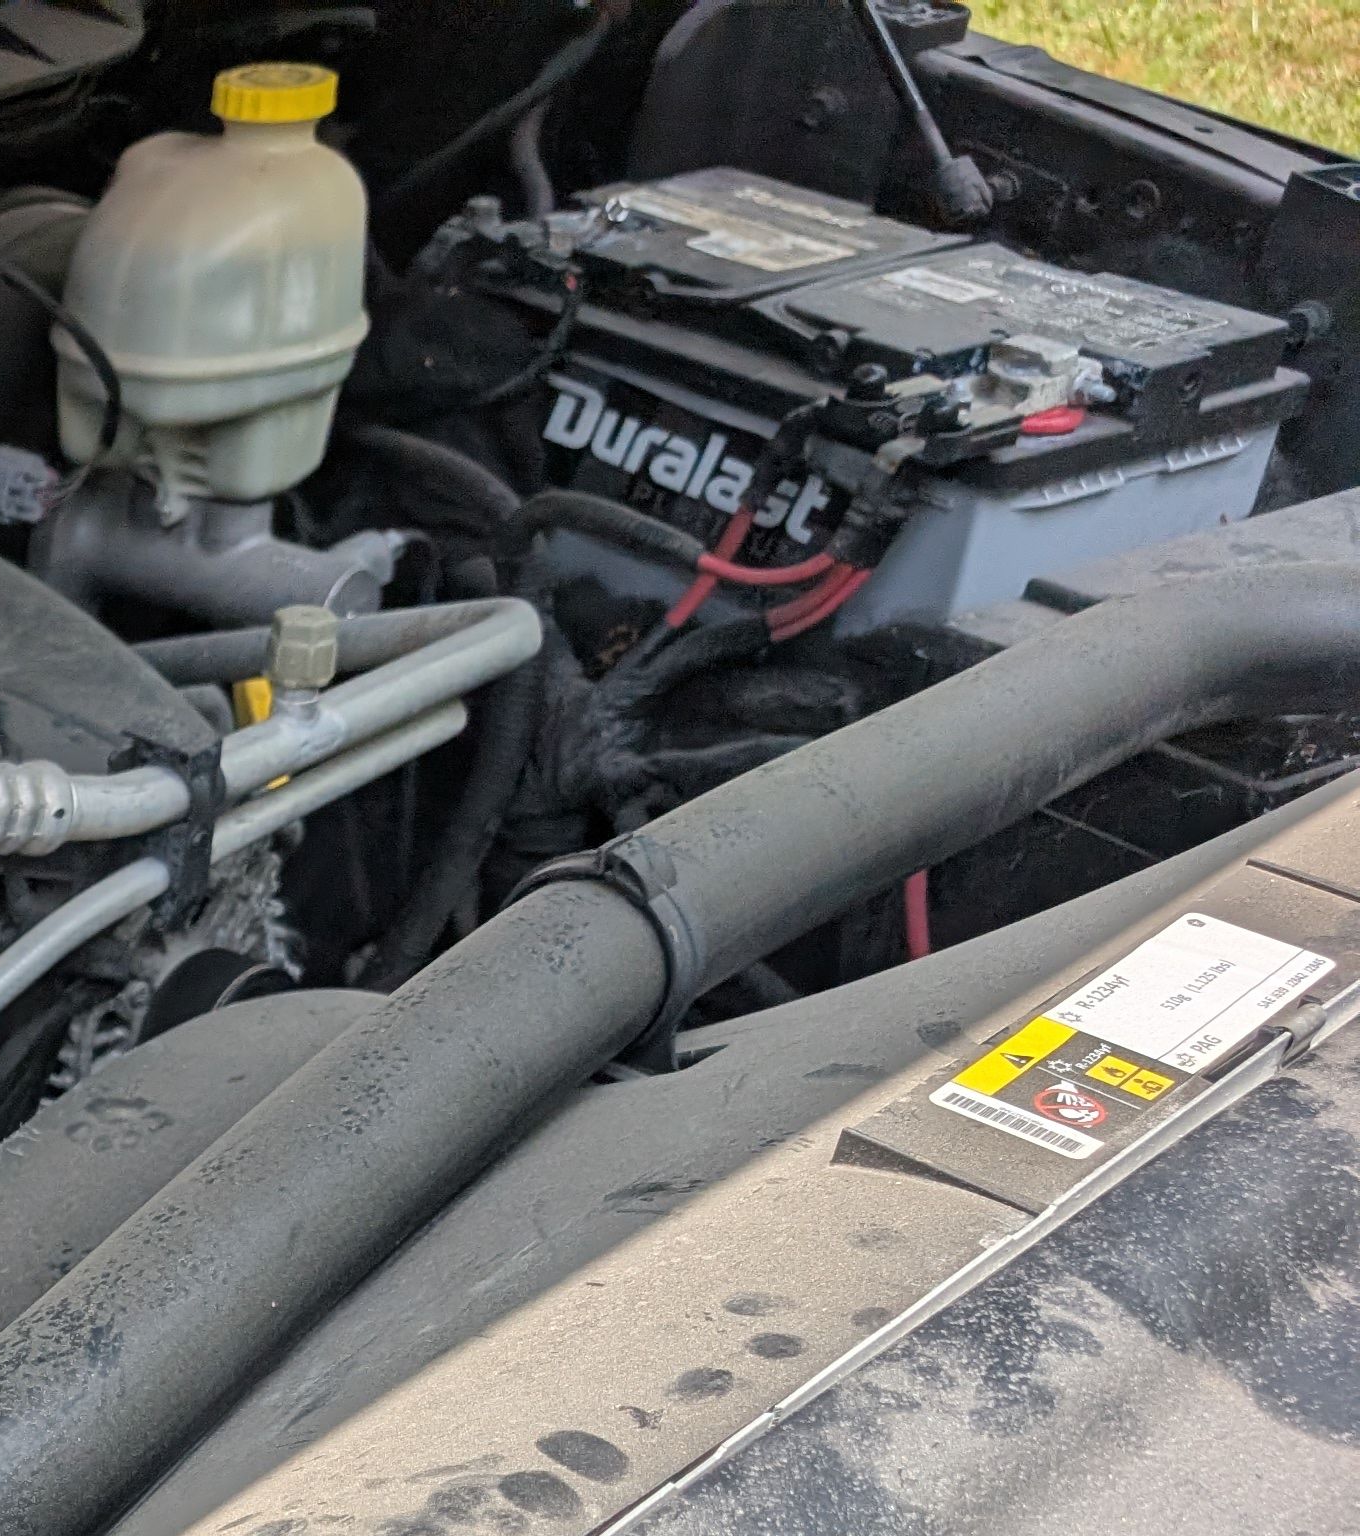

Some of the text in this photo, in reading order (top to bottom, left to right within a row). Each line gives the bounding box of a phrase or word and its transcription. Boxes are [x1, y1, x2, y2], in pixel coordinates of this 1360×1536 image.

[1076, 974, 1130, 1010] R-1234yf
[1160, 993, 1192, 1011] 510g
[1213, 959, 1236, 976] lbs)
[1257, 997, 1276, 1010] SAE
[1074, 1043, 1112, 1070] R-1234yf
[1190, 1034, 1223, 1054] PAG
